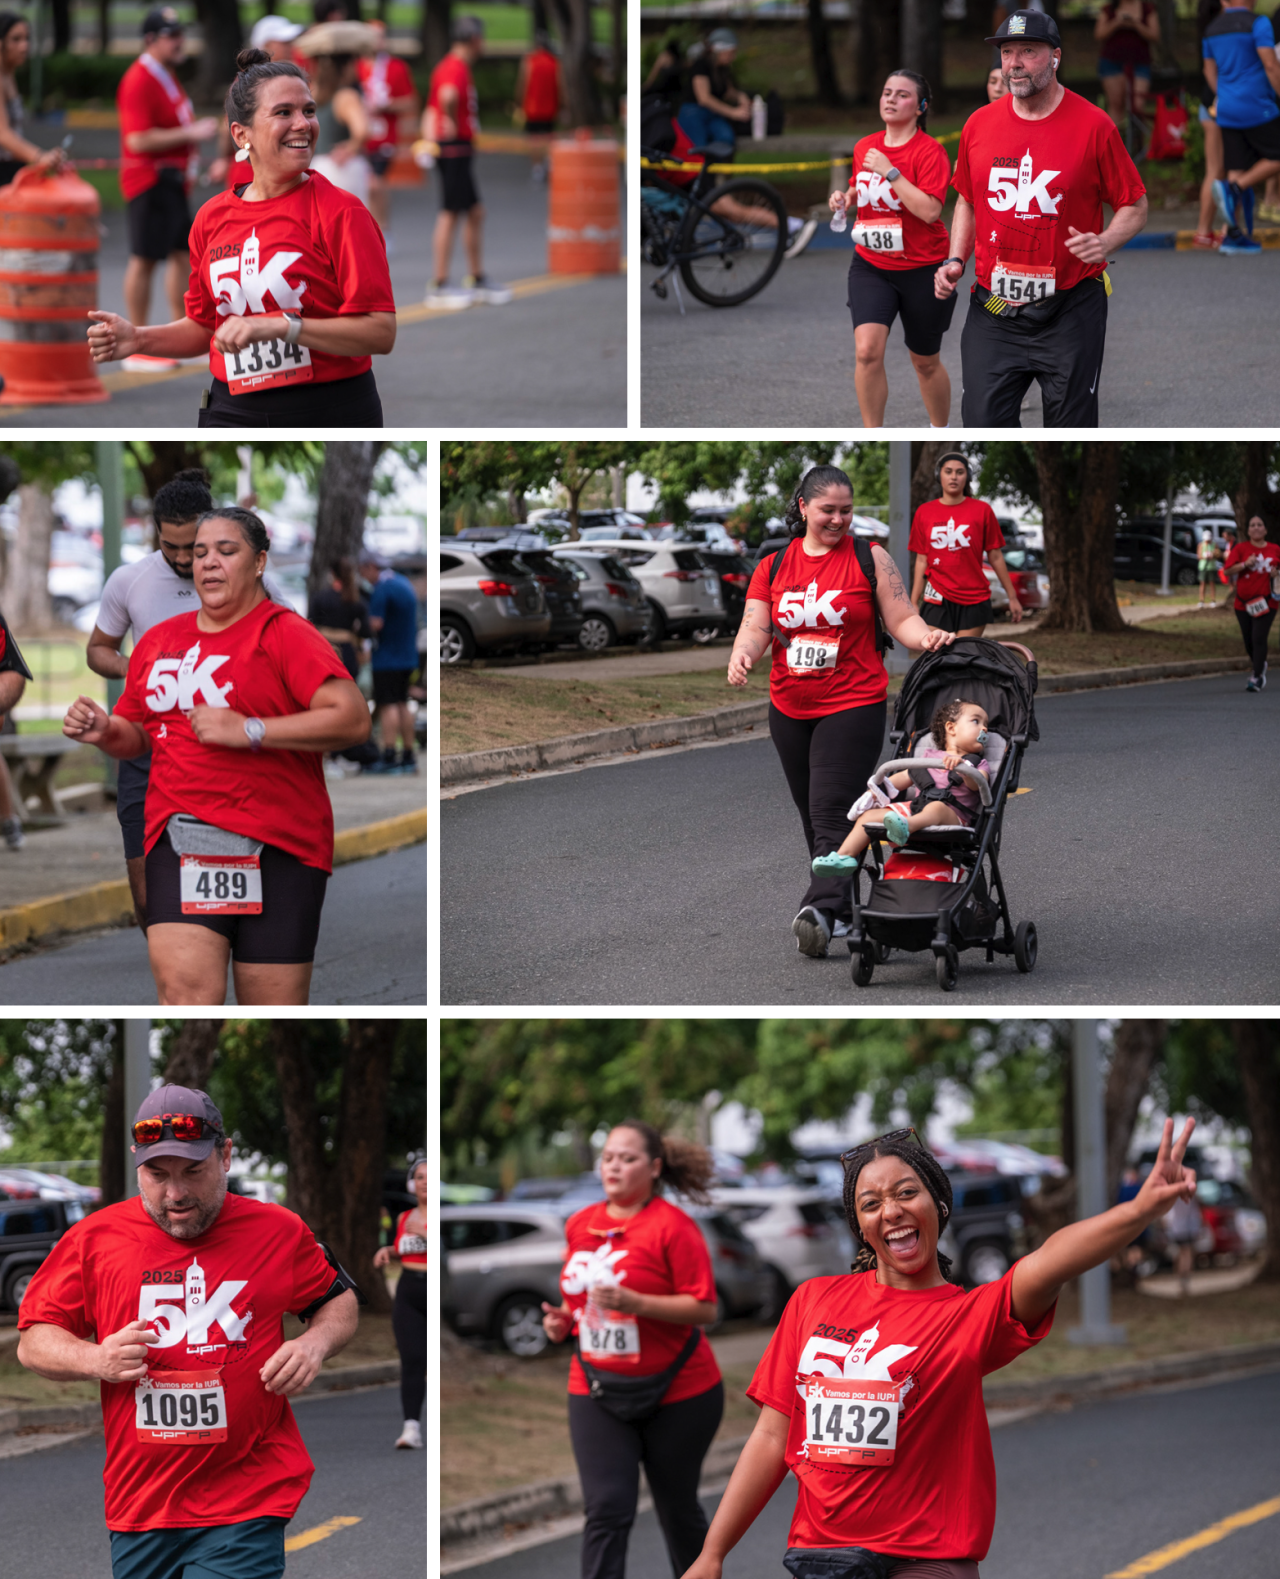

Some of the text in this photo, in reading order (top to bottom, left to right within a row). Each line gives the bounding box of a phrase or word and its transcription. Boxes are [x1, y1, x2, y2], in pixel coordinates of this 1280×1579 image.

[992, 157, 1019, 168] 2025
[987, 148, 1063, 215] 5K
[210, 243, 241, 263] 2025
[862, 231, 893, 249] 138
[209, 227, 308, 317] 5K
[1008, 269, 1025, 277] Vamos
[997, 277, 1047, 302] 1541
[233, 338, 303, 376] 1334
[930, 516, 971, 549] 5K
[777, 577, 847, 628] 5K
[794, 647, 827, 667] 198
[145, 640, 234, 713] 5K
[196, 871, 247, 899] 489
[141, 1270, 183, 1284] 2025
[138, 1256, 253, 1349] 5K
[813, 1324, 859, 1344] 2025
[155, 1381, 180, 1389] Vamos
[808, 1381, 826, 1398] 5K
[825, 1389, 850, 1400] Vamos
[852, 1391, 866, 1401] por
[867, 1390, 875, 1400] la
[142, 1392, 219, 1427] 1095
[811, 1403, 890, 1445] 1432
